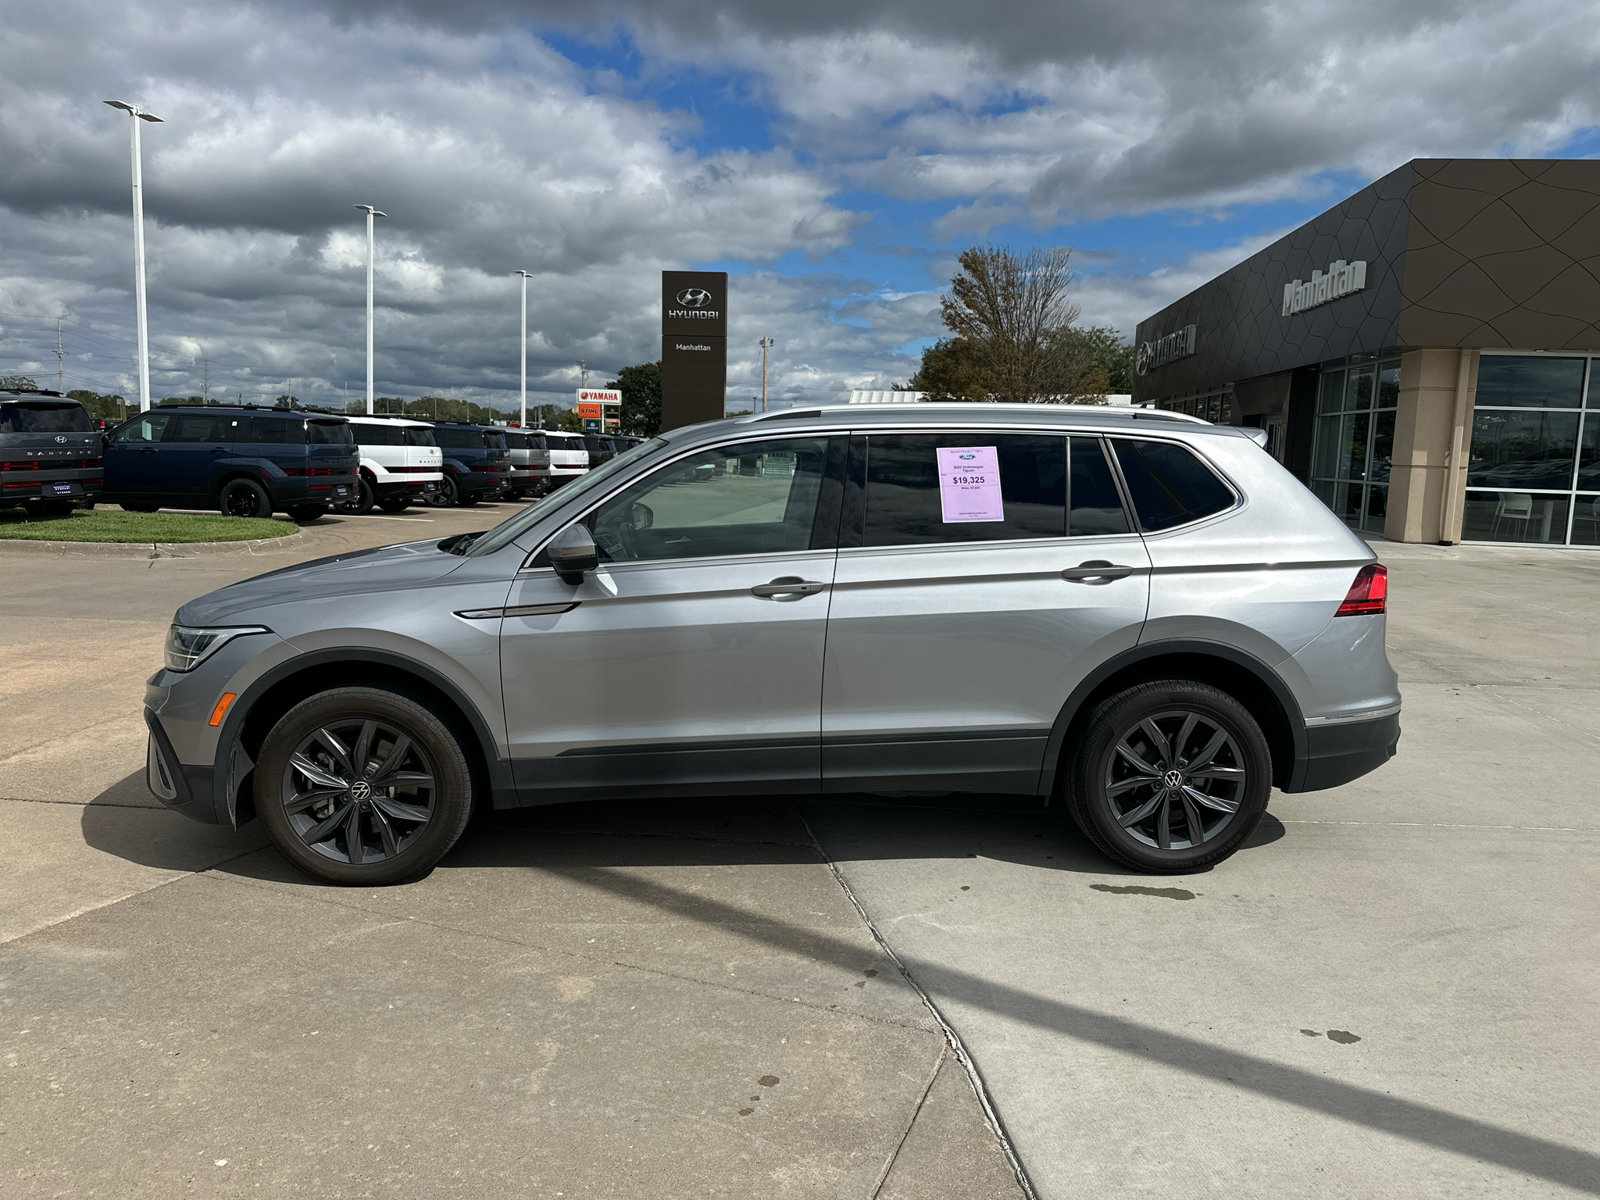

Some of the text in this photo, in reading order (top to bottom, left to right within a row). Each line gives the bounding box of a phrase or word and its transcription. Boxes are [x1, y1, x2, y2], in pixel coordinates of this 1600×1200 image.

[1282, 260, 1366, 316] Manhattan
[668, 310, 718, 320] HYUNDAI
[675, 343, 711, 352] Manhattan
[589, 392, 618, 400] YAMAHA
[953, 476, 985, 484] $19,325
